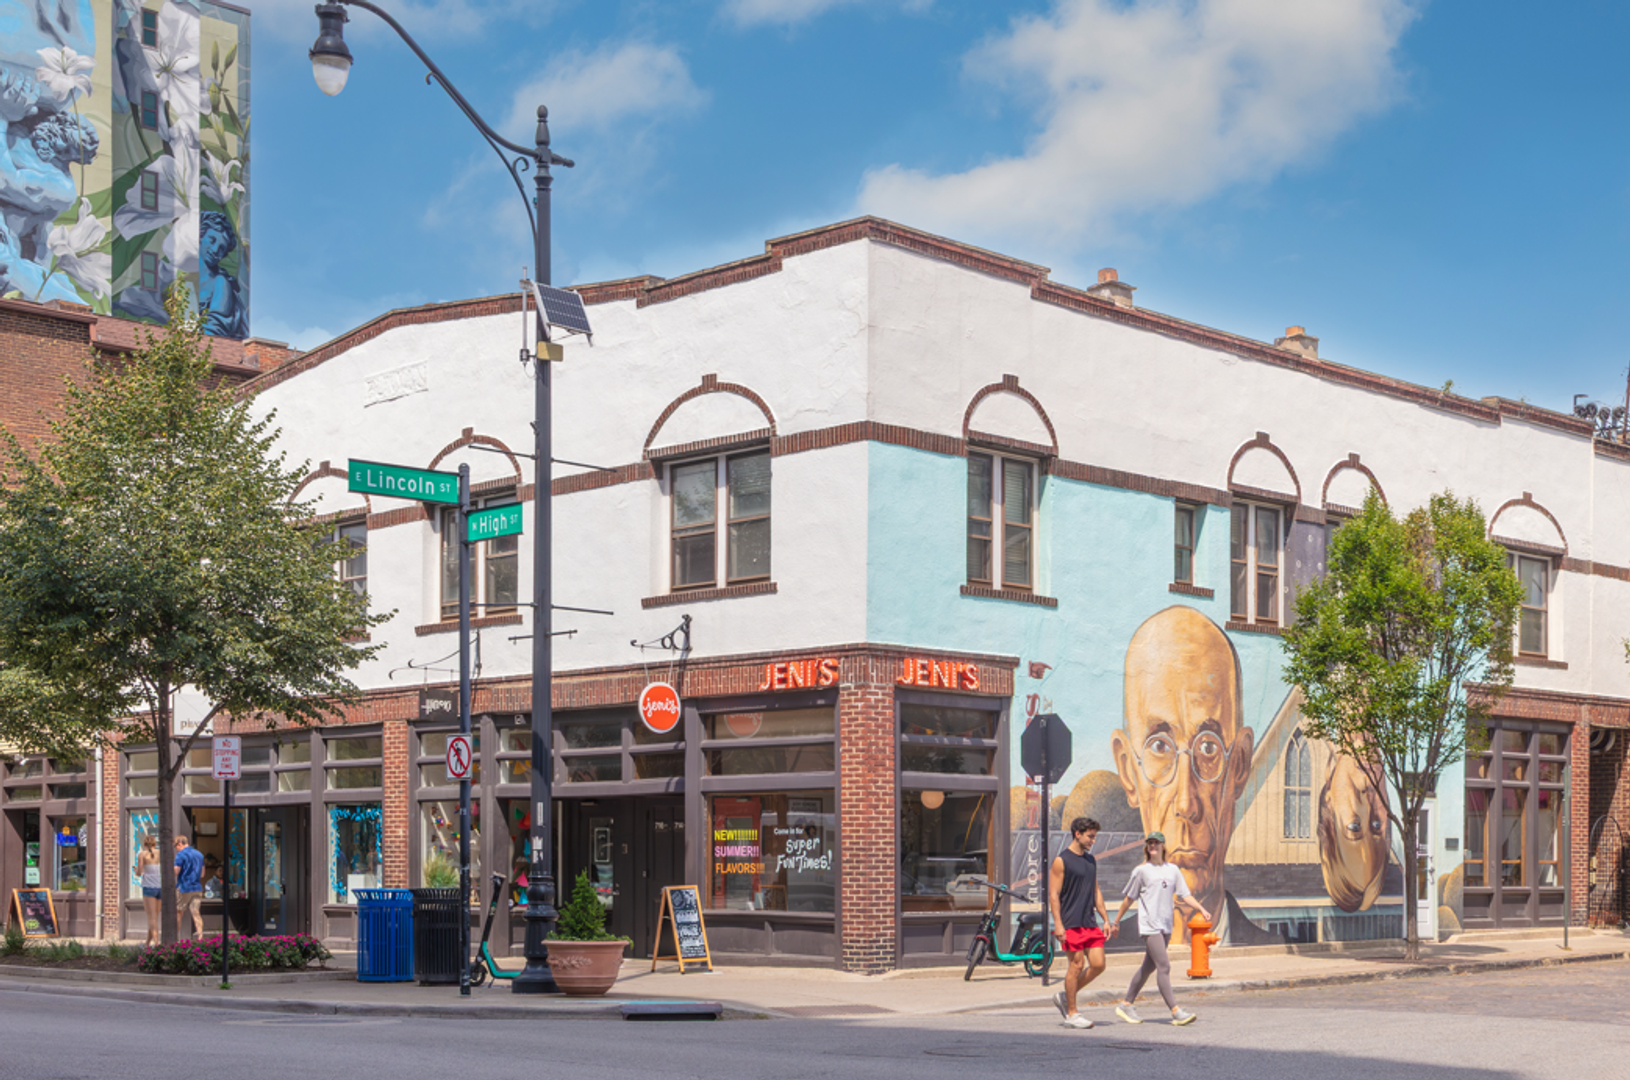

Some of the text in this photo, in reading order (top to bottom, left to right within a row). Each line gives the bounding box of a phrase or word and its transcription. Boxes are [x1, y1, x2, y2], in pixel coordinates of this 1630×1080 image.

[355, 469, 451, 495] E Lincoln ST
[479, 513, 508, 536] High
[759, 657, 839, 691] JENI'S
[897, 657, 980, 690] JENI'S
[642, 697, 680, 718] jeni's
[774, 827, 804, 835] Come in for
[714, 845, 760, 857] SUMMER!!
